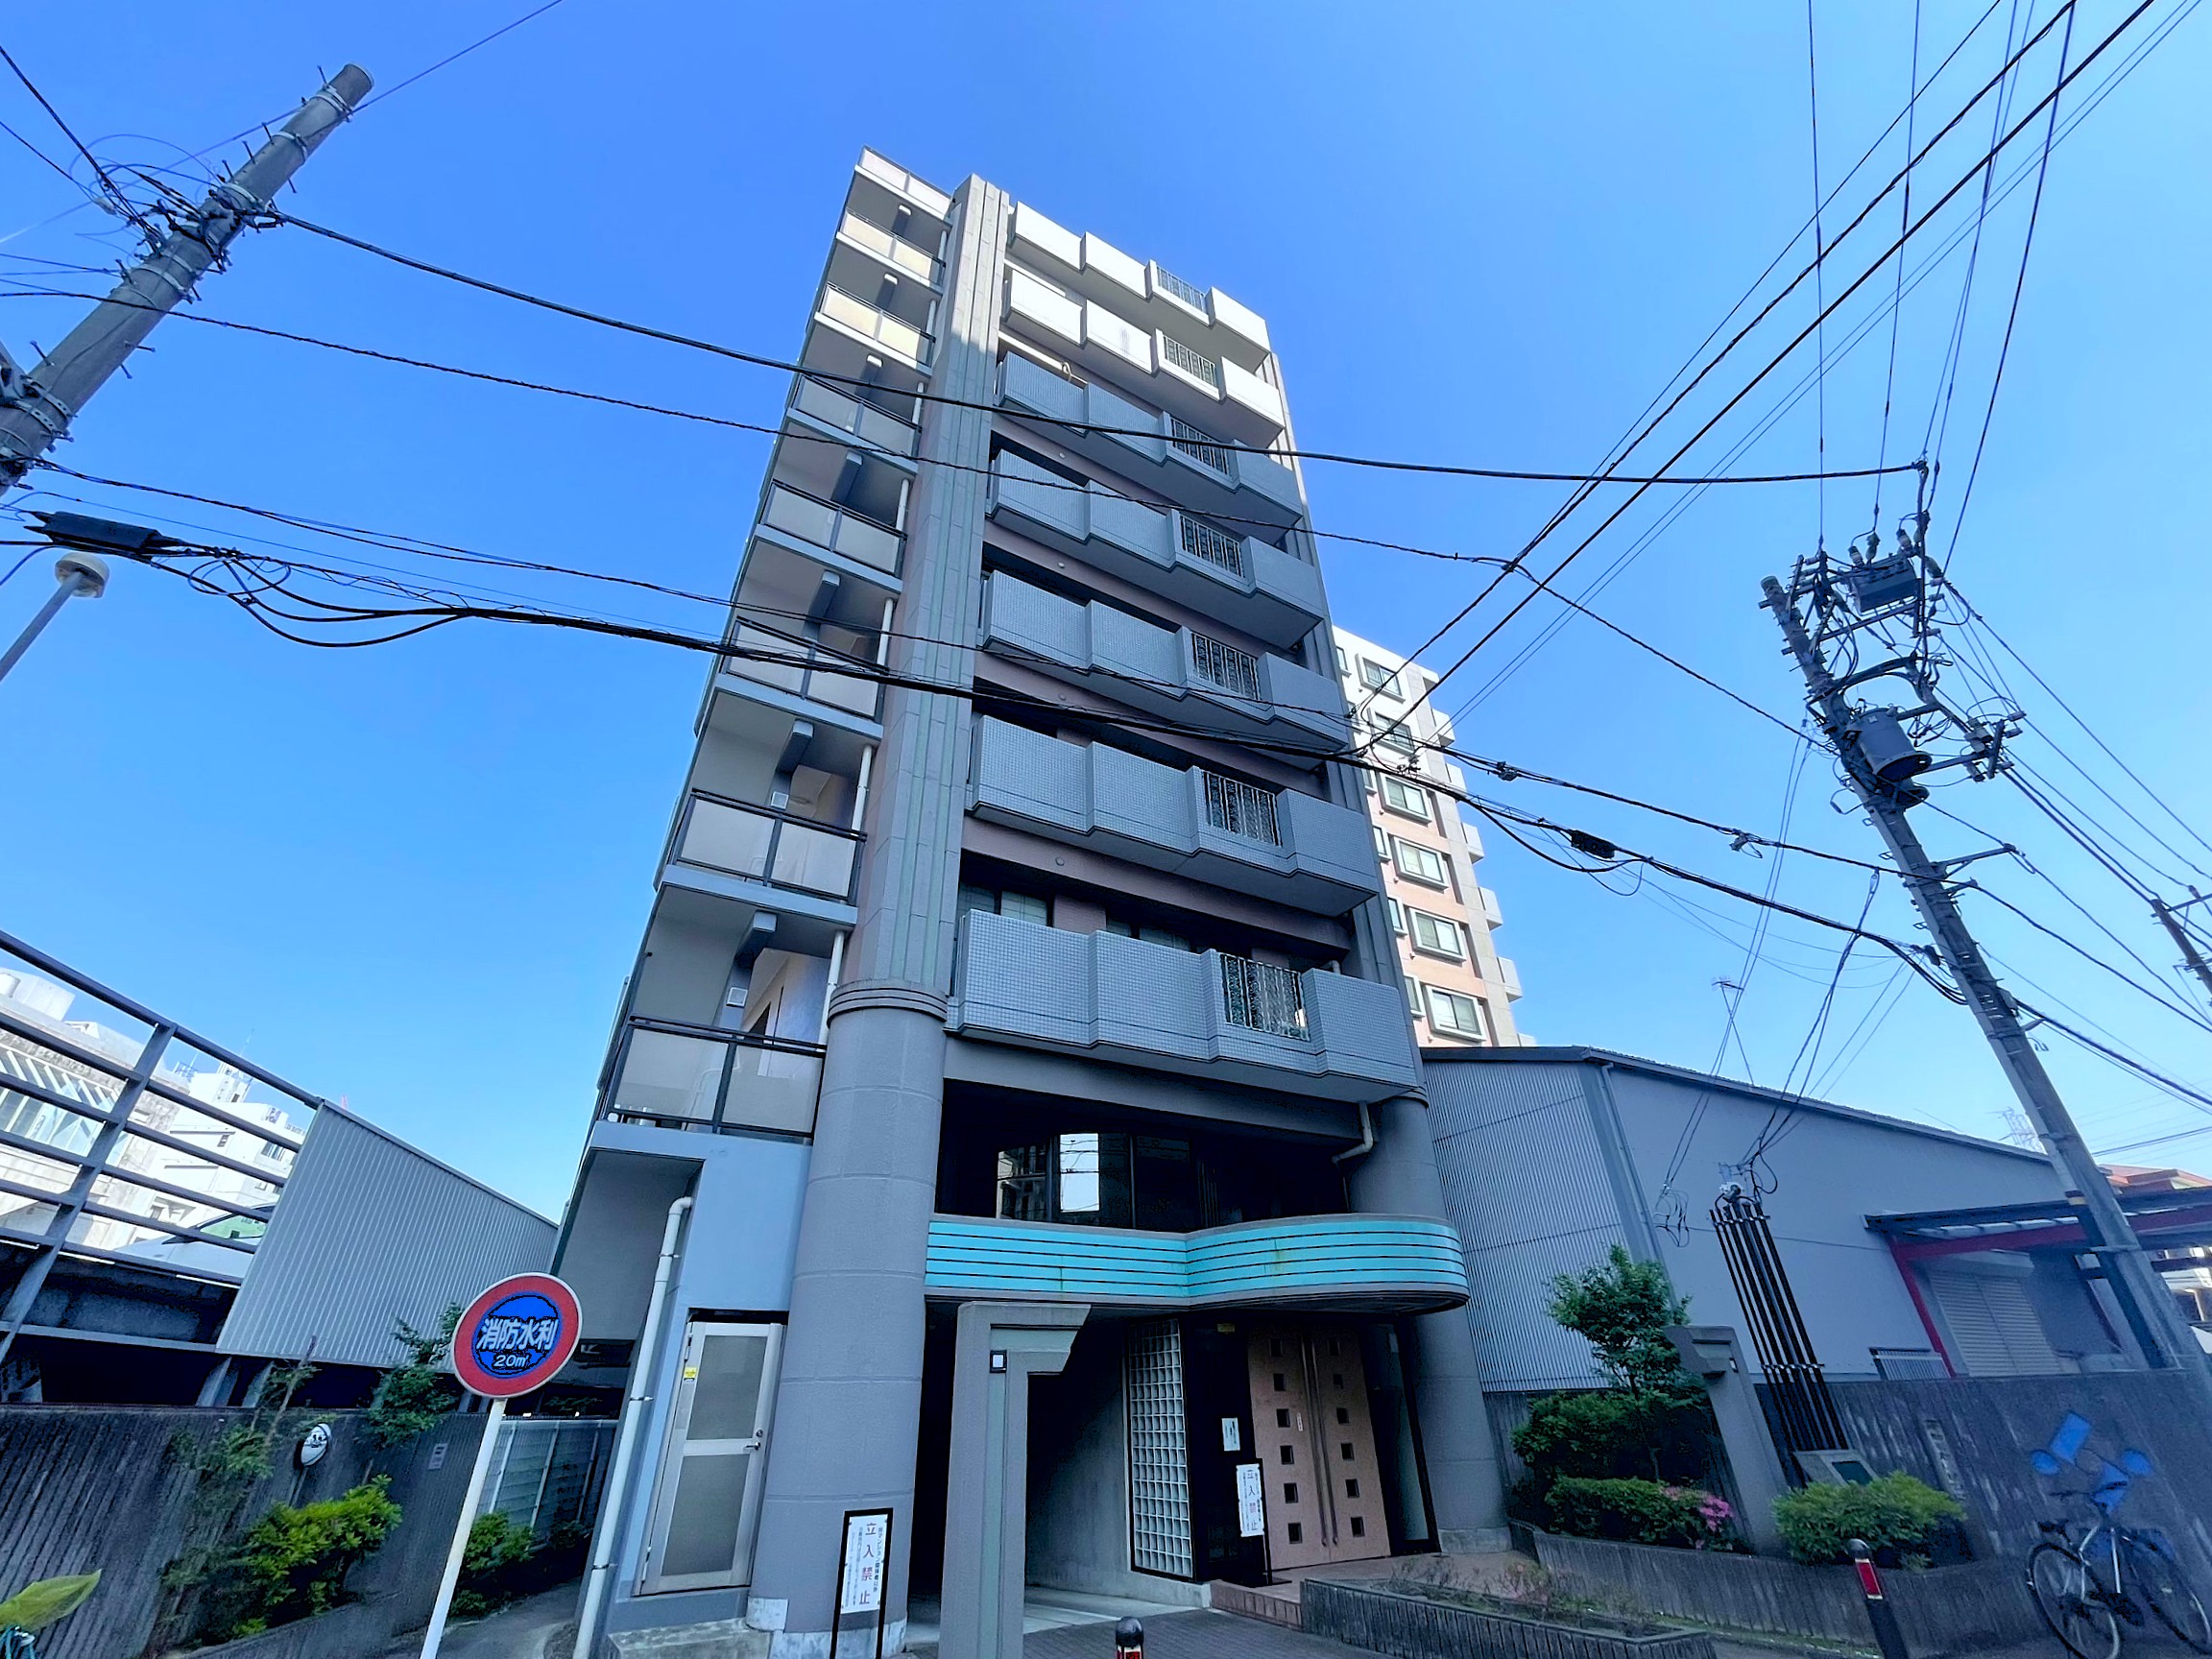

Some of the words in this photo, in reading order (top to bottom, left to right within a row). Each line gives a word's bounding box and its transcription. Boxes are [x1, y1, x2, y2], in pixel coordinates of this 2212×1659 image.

[476, 1318, 559, 1350] 消防水利
[859, 1523, 877, 1604] 立入禁止
